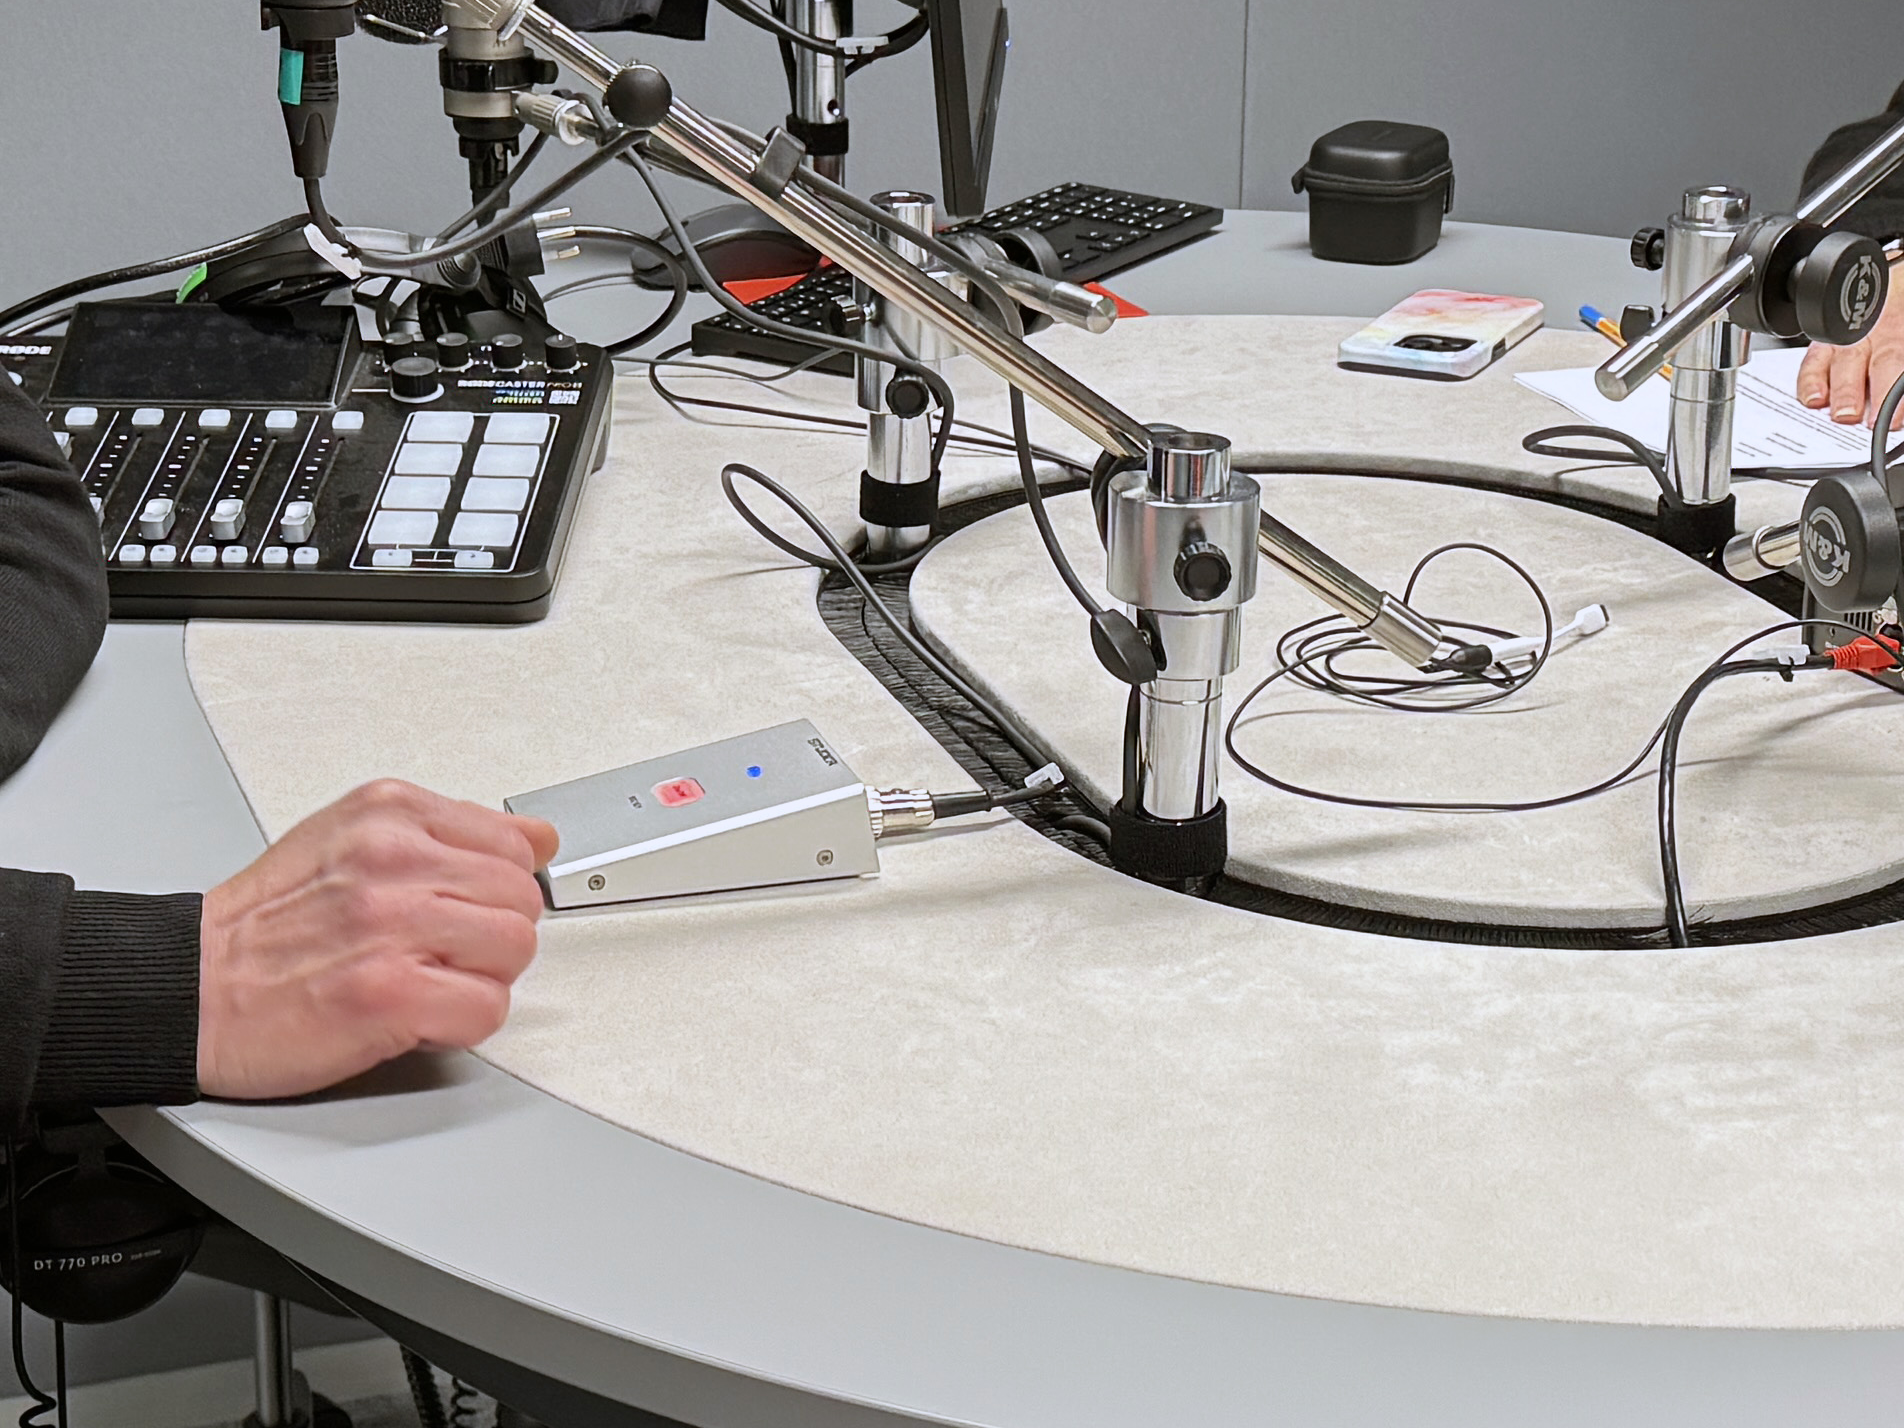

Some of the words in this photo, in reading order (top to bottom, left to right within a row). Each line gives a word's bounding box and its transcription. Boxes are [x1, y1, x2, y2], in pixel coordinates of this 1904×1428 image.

[1848, 255, 1872, 330] K&M
[1803, 520, 1851, 574] K&M
[34, 1259, 54, 1271] DT
[58, 1257, 86, 1271] 770
[91, 1252, 123, 1267] PRO
